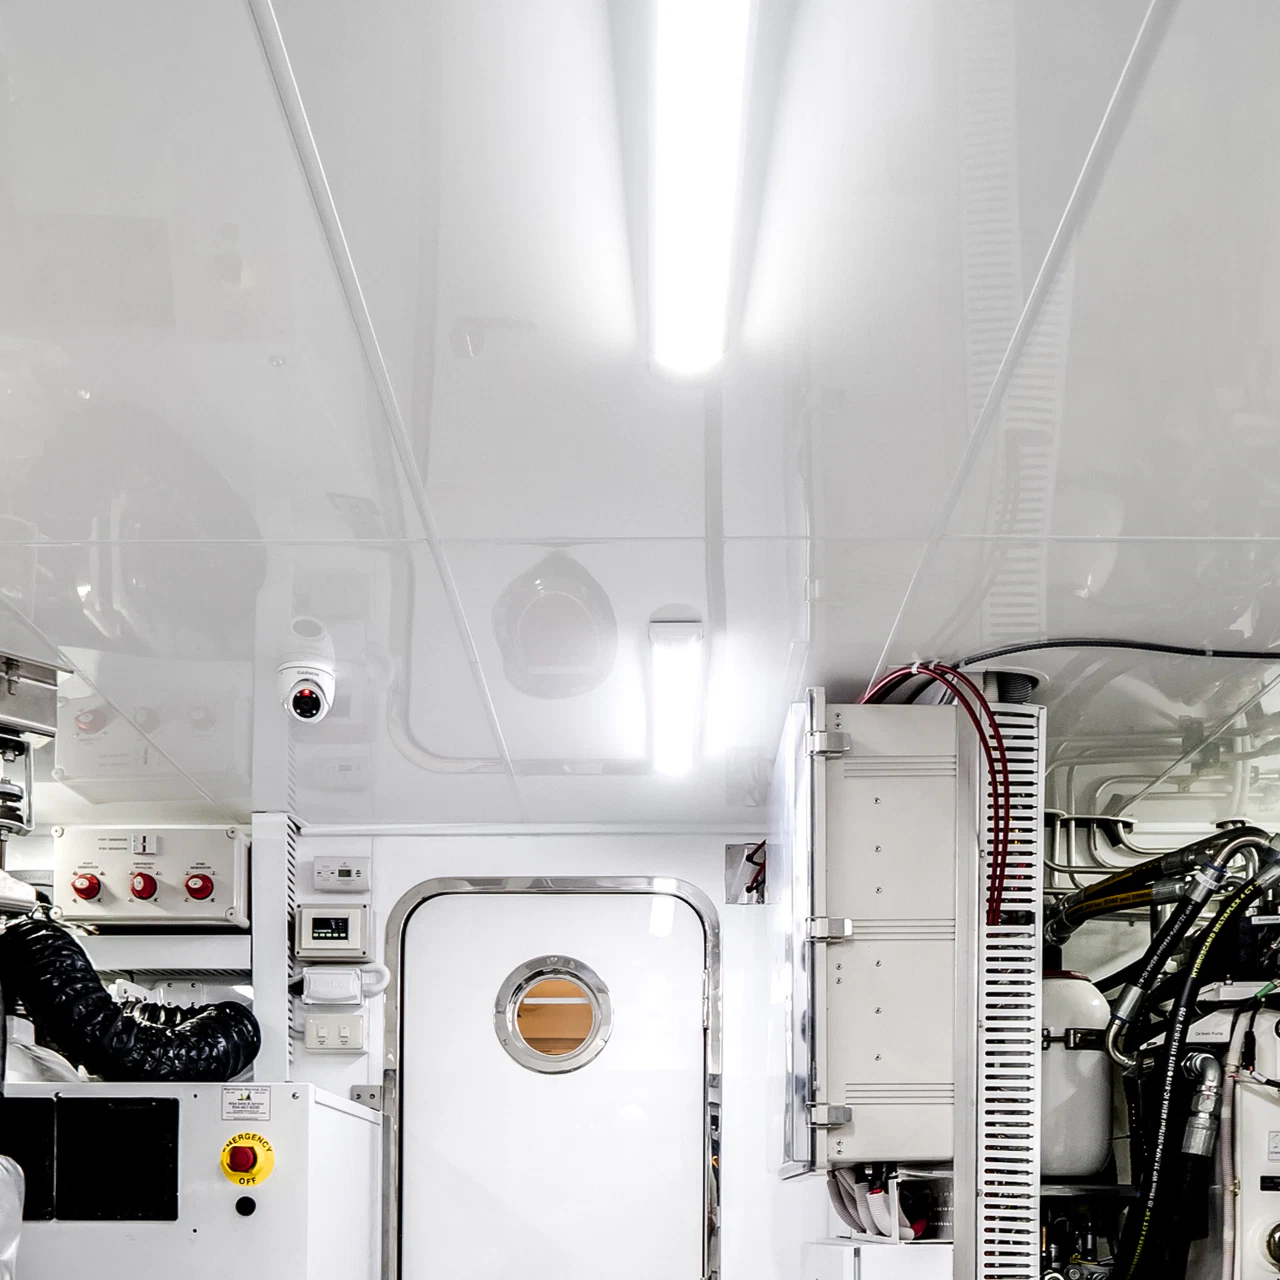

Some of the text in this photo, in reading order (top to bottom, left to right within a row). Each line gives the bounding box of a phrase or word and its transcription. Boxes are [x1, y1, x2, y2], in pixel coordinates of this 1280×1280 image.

[1190, 932, 1216, 978] HYDROSCAND
[1213, 898, 1241, 933] DELTAFLEX
[1244, 885, 1254, 894] CT
[1160, 1100, 1169, 1119] MSHA
[1179, 1006, 1187, 1021] 4/20
[223, 1133, 272, 1152] MERGENCY
[238, 1177, 256, 1185] OFF
